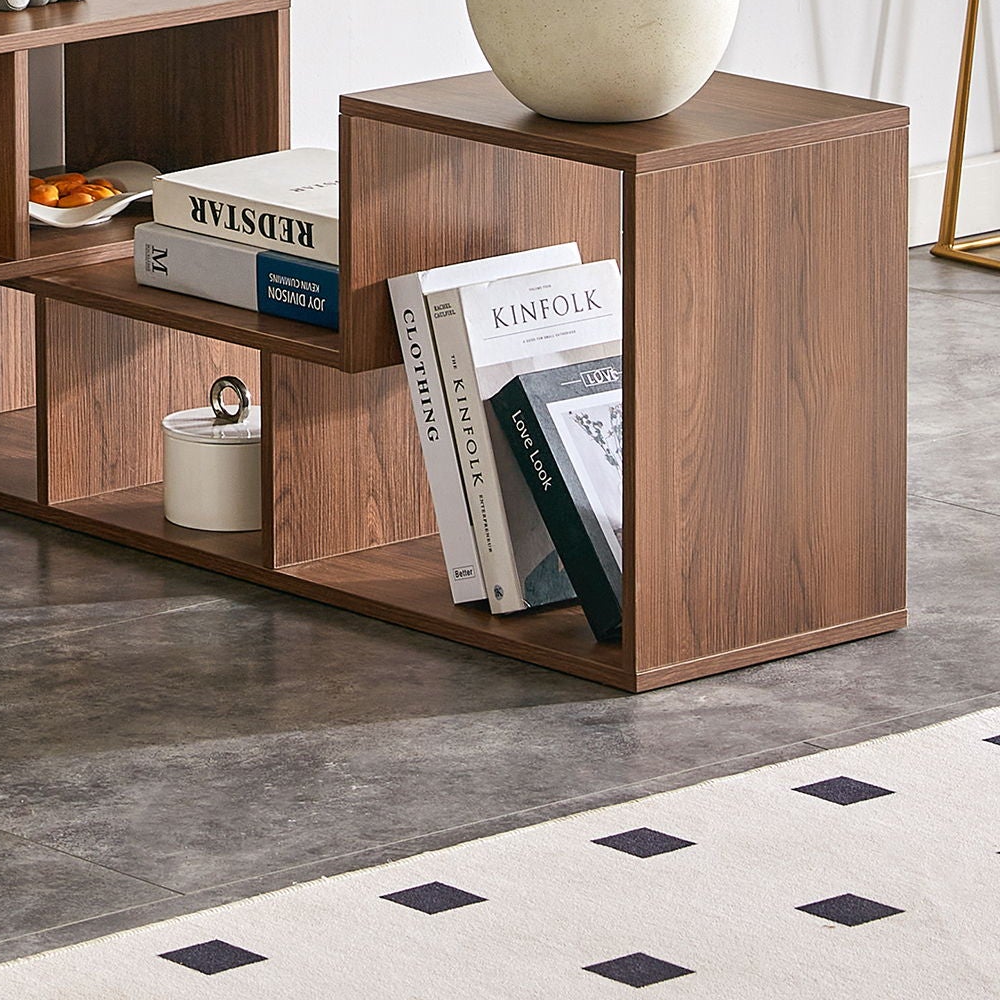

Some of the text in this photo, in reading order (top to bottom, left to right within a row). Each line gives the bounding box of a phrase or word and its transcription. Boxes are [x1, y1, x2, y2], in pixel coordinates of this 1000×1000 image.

[188, 195, 315, 249] REDSTAR
[267, 286, 326, 312] JOY DIVISON
[268, 272, 320, 293] KEVIN CUMMINS
[491, 288, 602, 329] KINFOLK
[403, 308, 440, 443] CLOTHING
[453, 379, 484, 487] KINFOLK
[511, 409, 552, 491] Love Look
